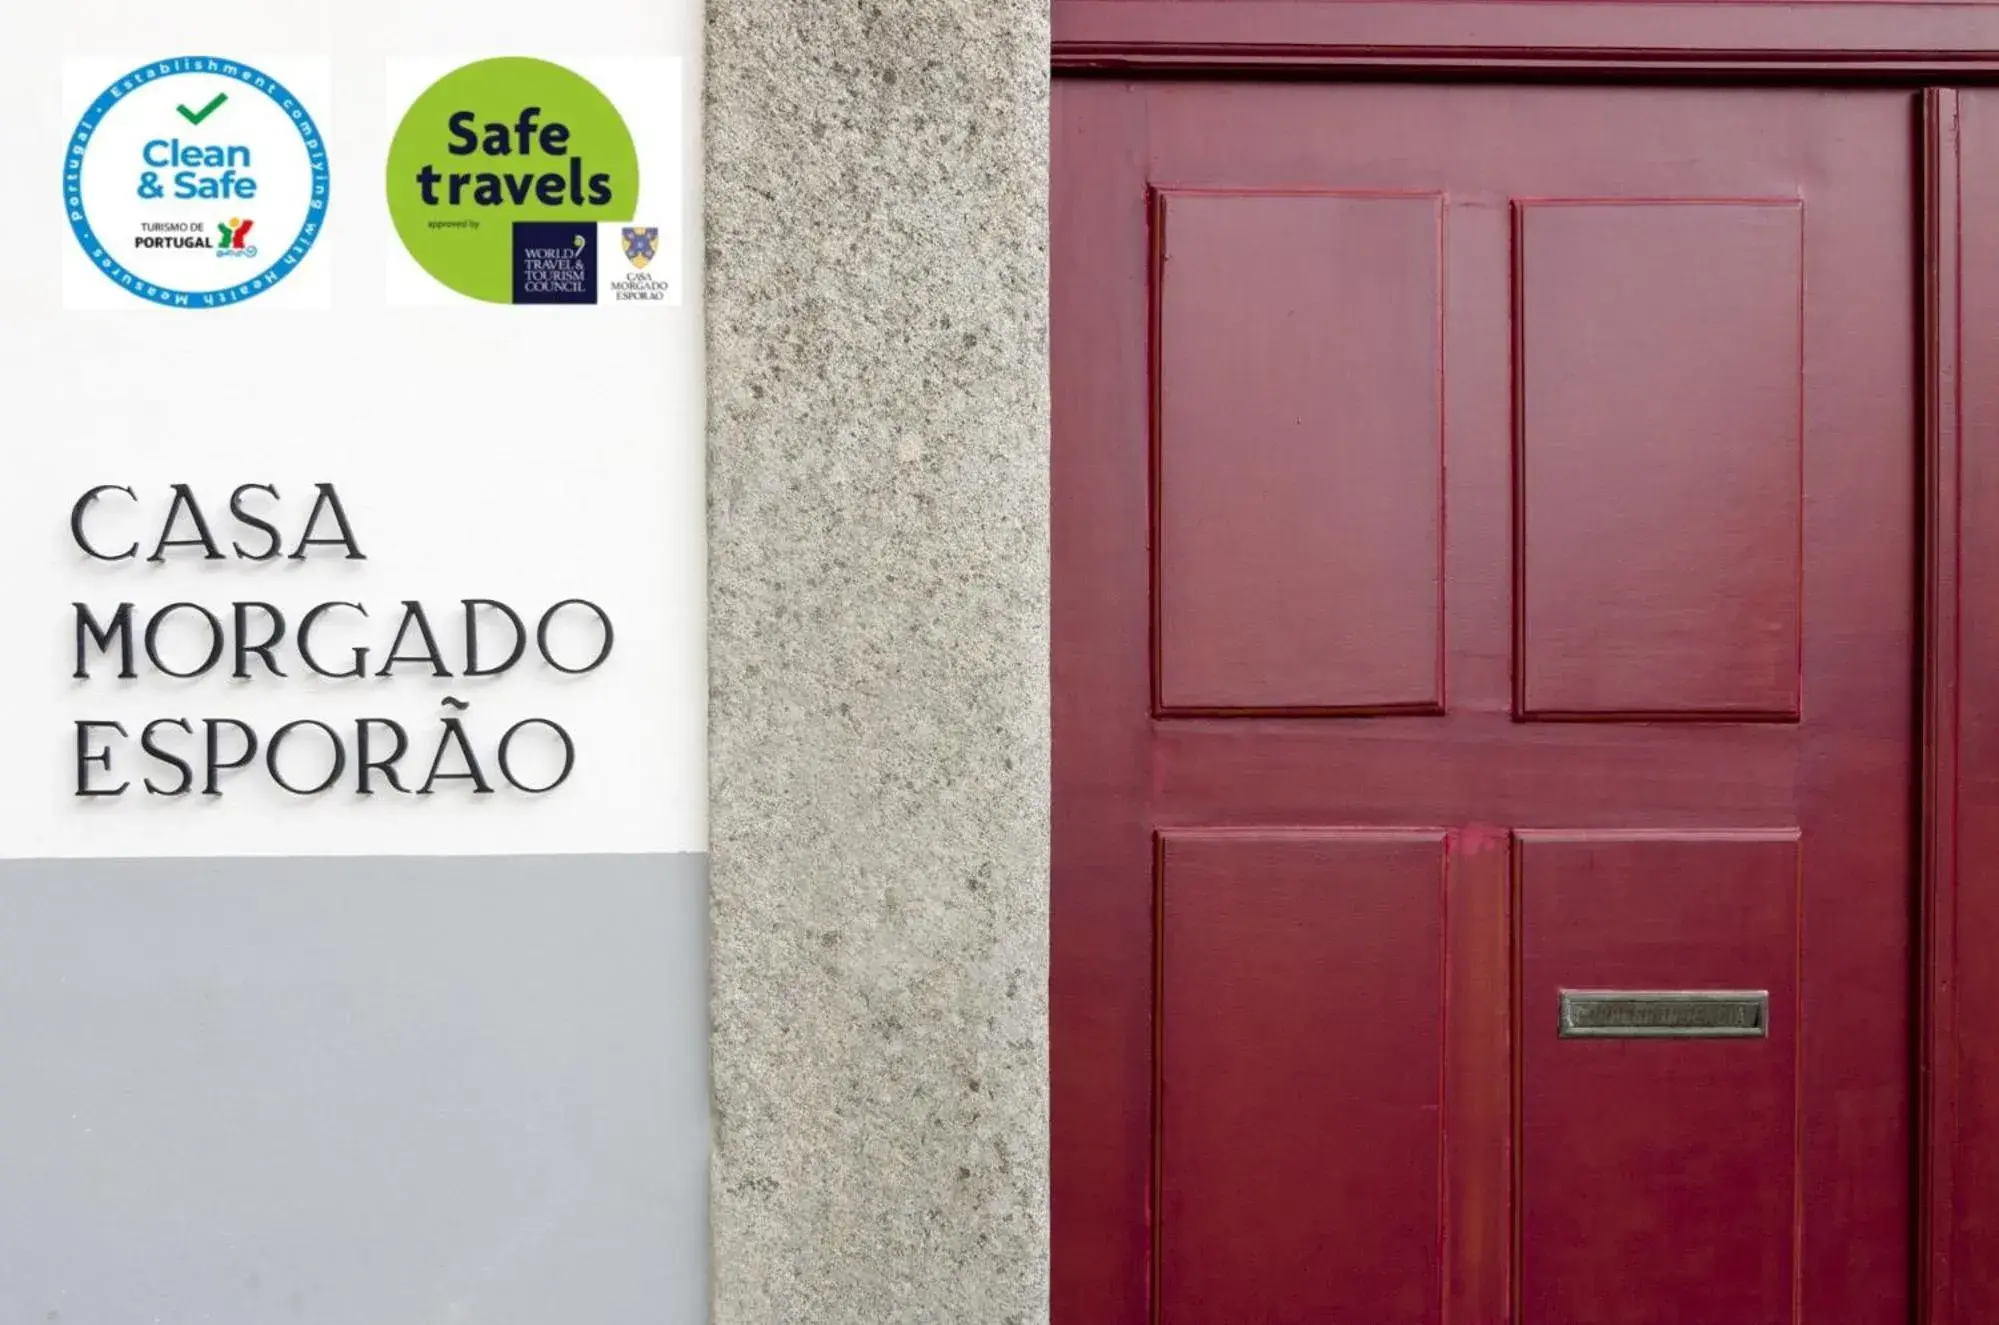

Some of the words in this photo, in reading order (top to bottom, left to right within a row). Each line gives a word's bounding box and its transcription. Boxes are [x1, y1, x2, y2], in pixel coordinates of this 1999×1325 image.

[71, 483, 367, 562] CASA
[72, 598, 614, 679] MORGADO
[74, 695, 576, 796] ESPORÃO
